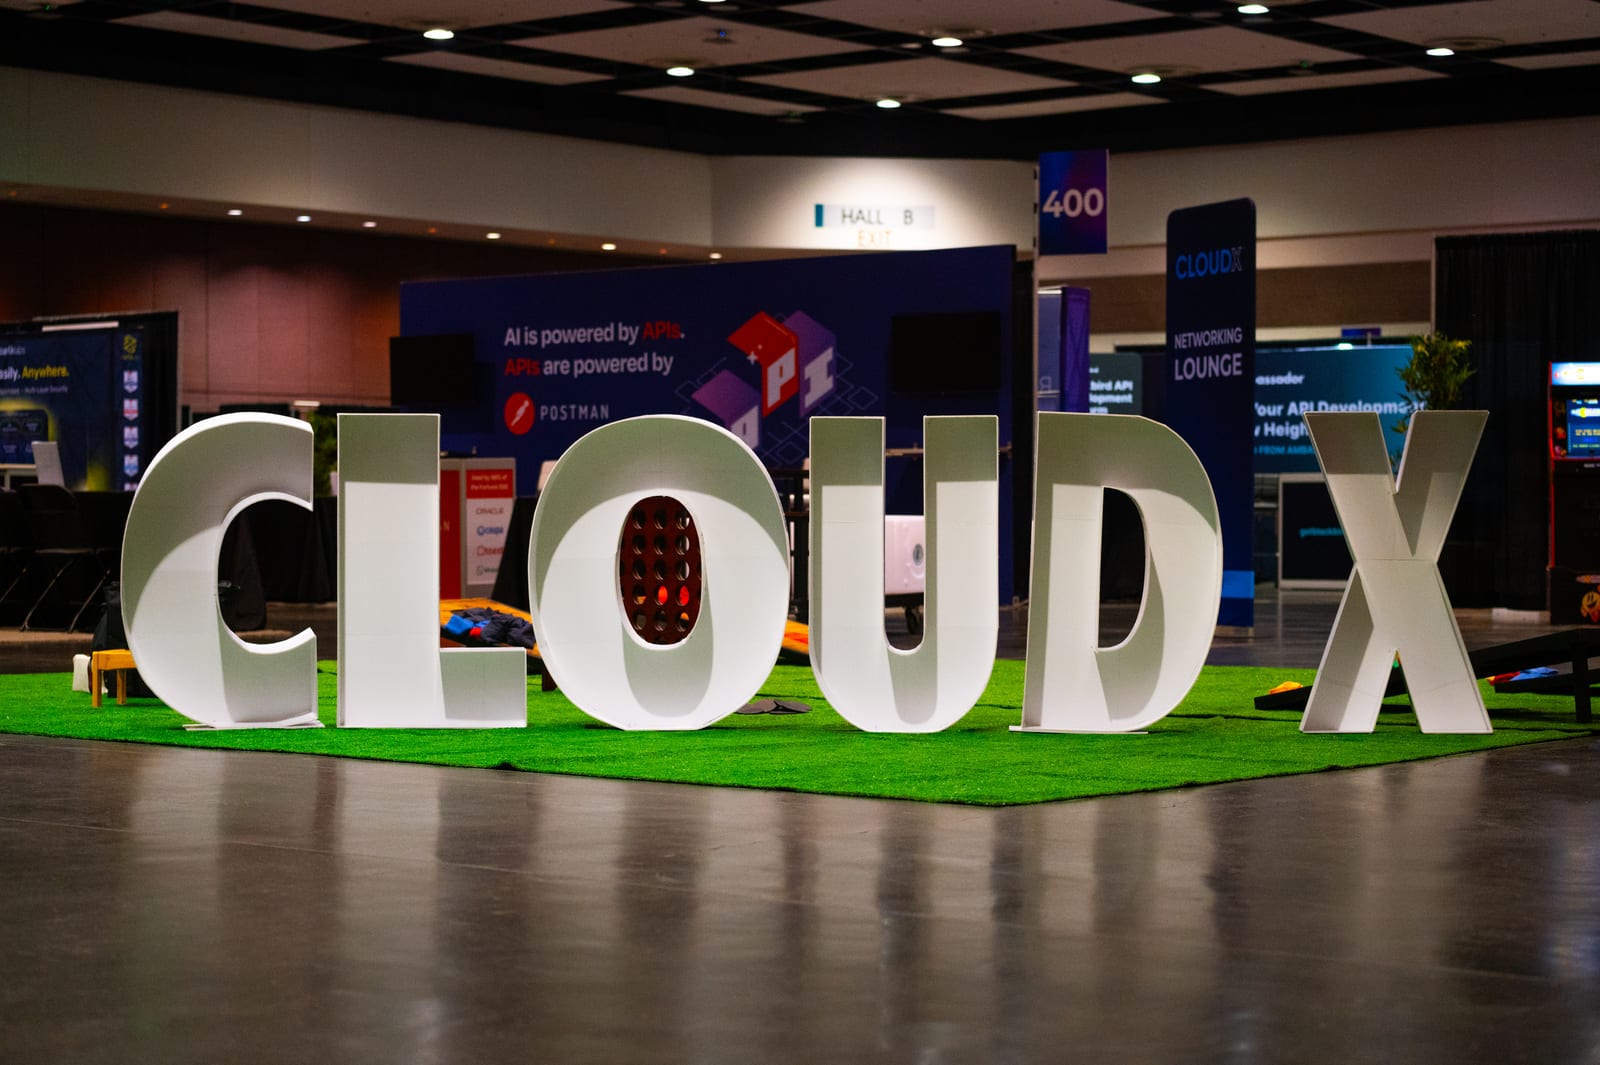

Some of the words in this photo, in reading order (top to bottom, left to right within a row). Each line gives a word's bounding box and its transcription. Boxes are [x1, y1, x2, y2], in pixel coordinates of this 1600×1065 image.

[1042, 187, 1104, 218] 400
[841, 208, 885, 225] HALL
[903, 208, 914, 226] B
[857, 229, 893, 247] EXIT
[1175, 246, 1243, 280] CLOUDX
[503, 327, 521, 346] AI
[524, 326, 539, 346] is
[540, 322, 615, 349] powered
[617, 321, 640, 346] by
[1174, 327, 1243, 349] NETWORKING
[504, 357, 541, 376] APIs
[542, 358, 570, 376] are
[573, 352, 649, 379] powered
[651, 351, 674, 376] by
[1174, 353, 1243, 381] LOUNGE
[1114, 380, 1134, 391] API
[540, 404, 610, 421] POSTMAN
[1287, 400, 1314, 416] API
